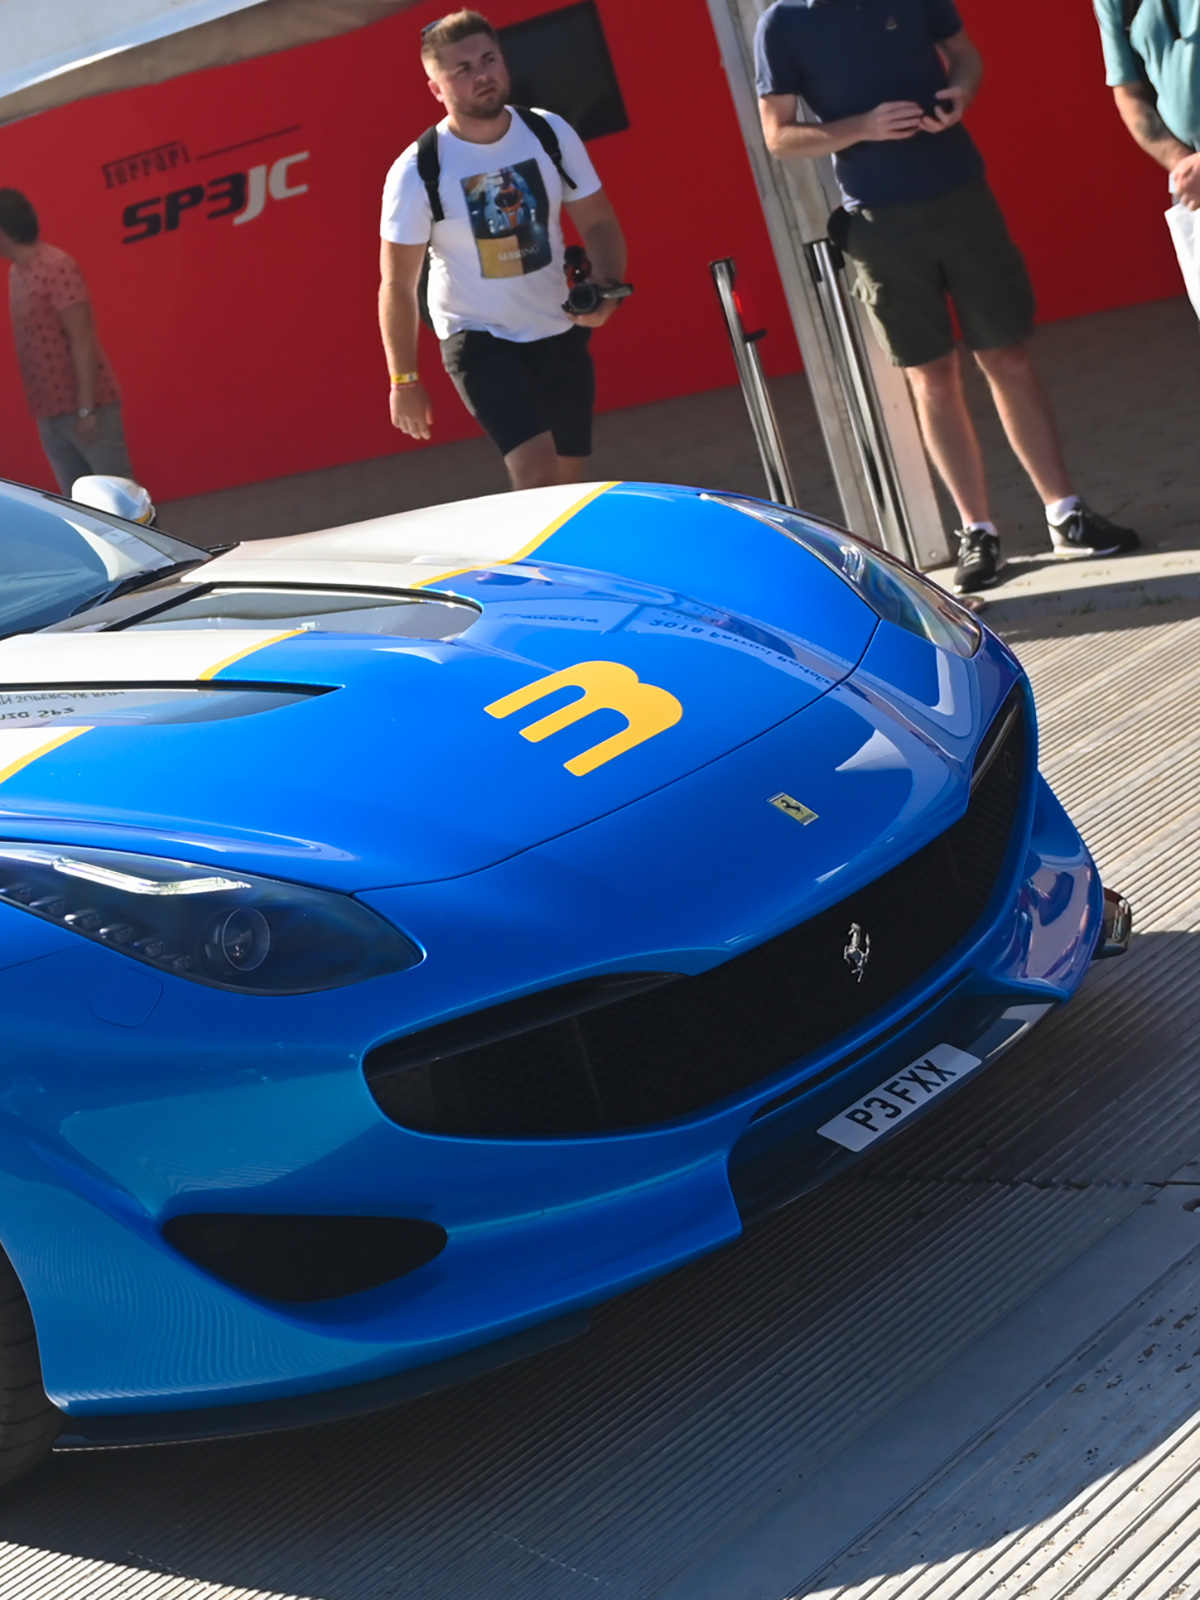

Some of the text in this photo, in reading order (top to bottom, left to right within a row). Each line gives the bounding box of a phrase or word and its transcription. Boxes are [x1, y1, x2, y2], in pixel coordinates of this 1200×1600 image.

[102, 139, 193, 190] Ferrari
[122, 151, 310, 244] SP3JC
[483, 660, 683, 777] 3
[844, 1058, 957, 1133] P3 FXX
